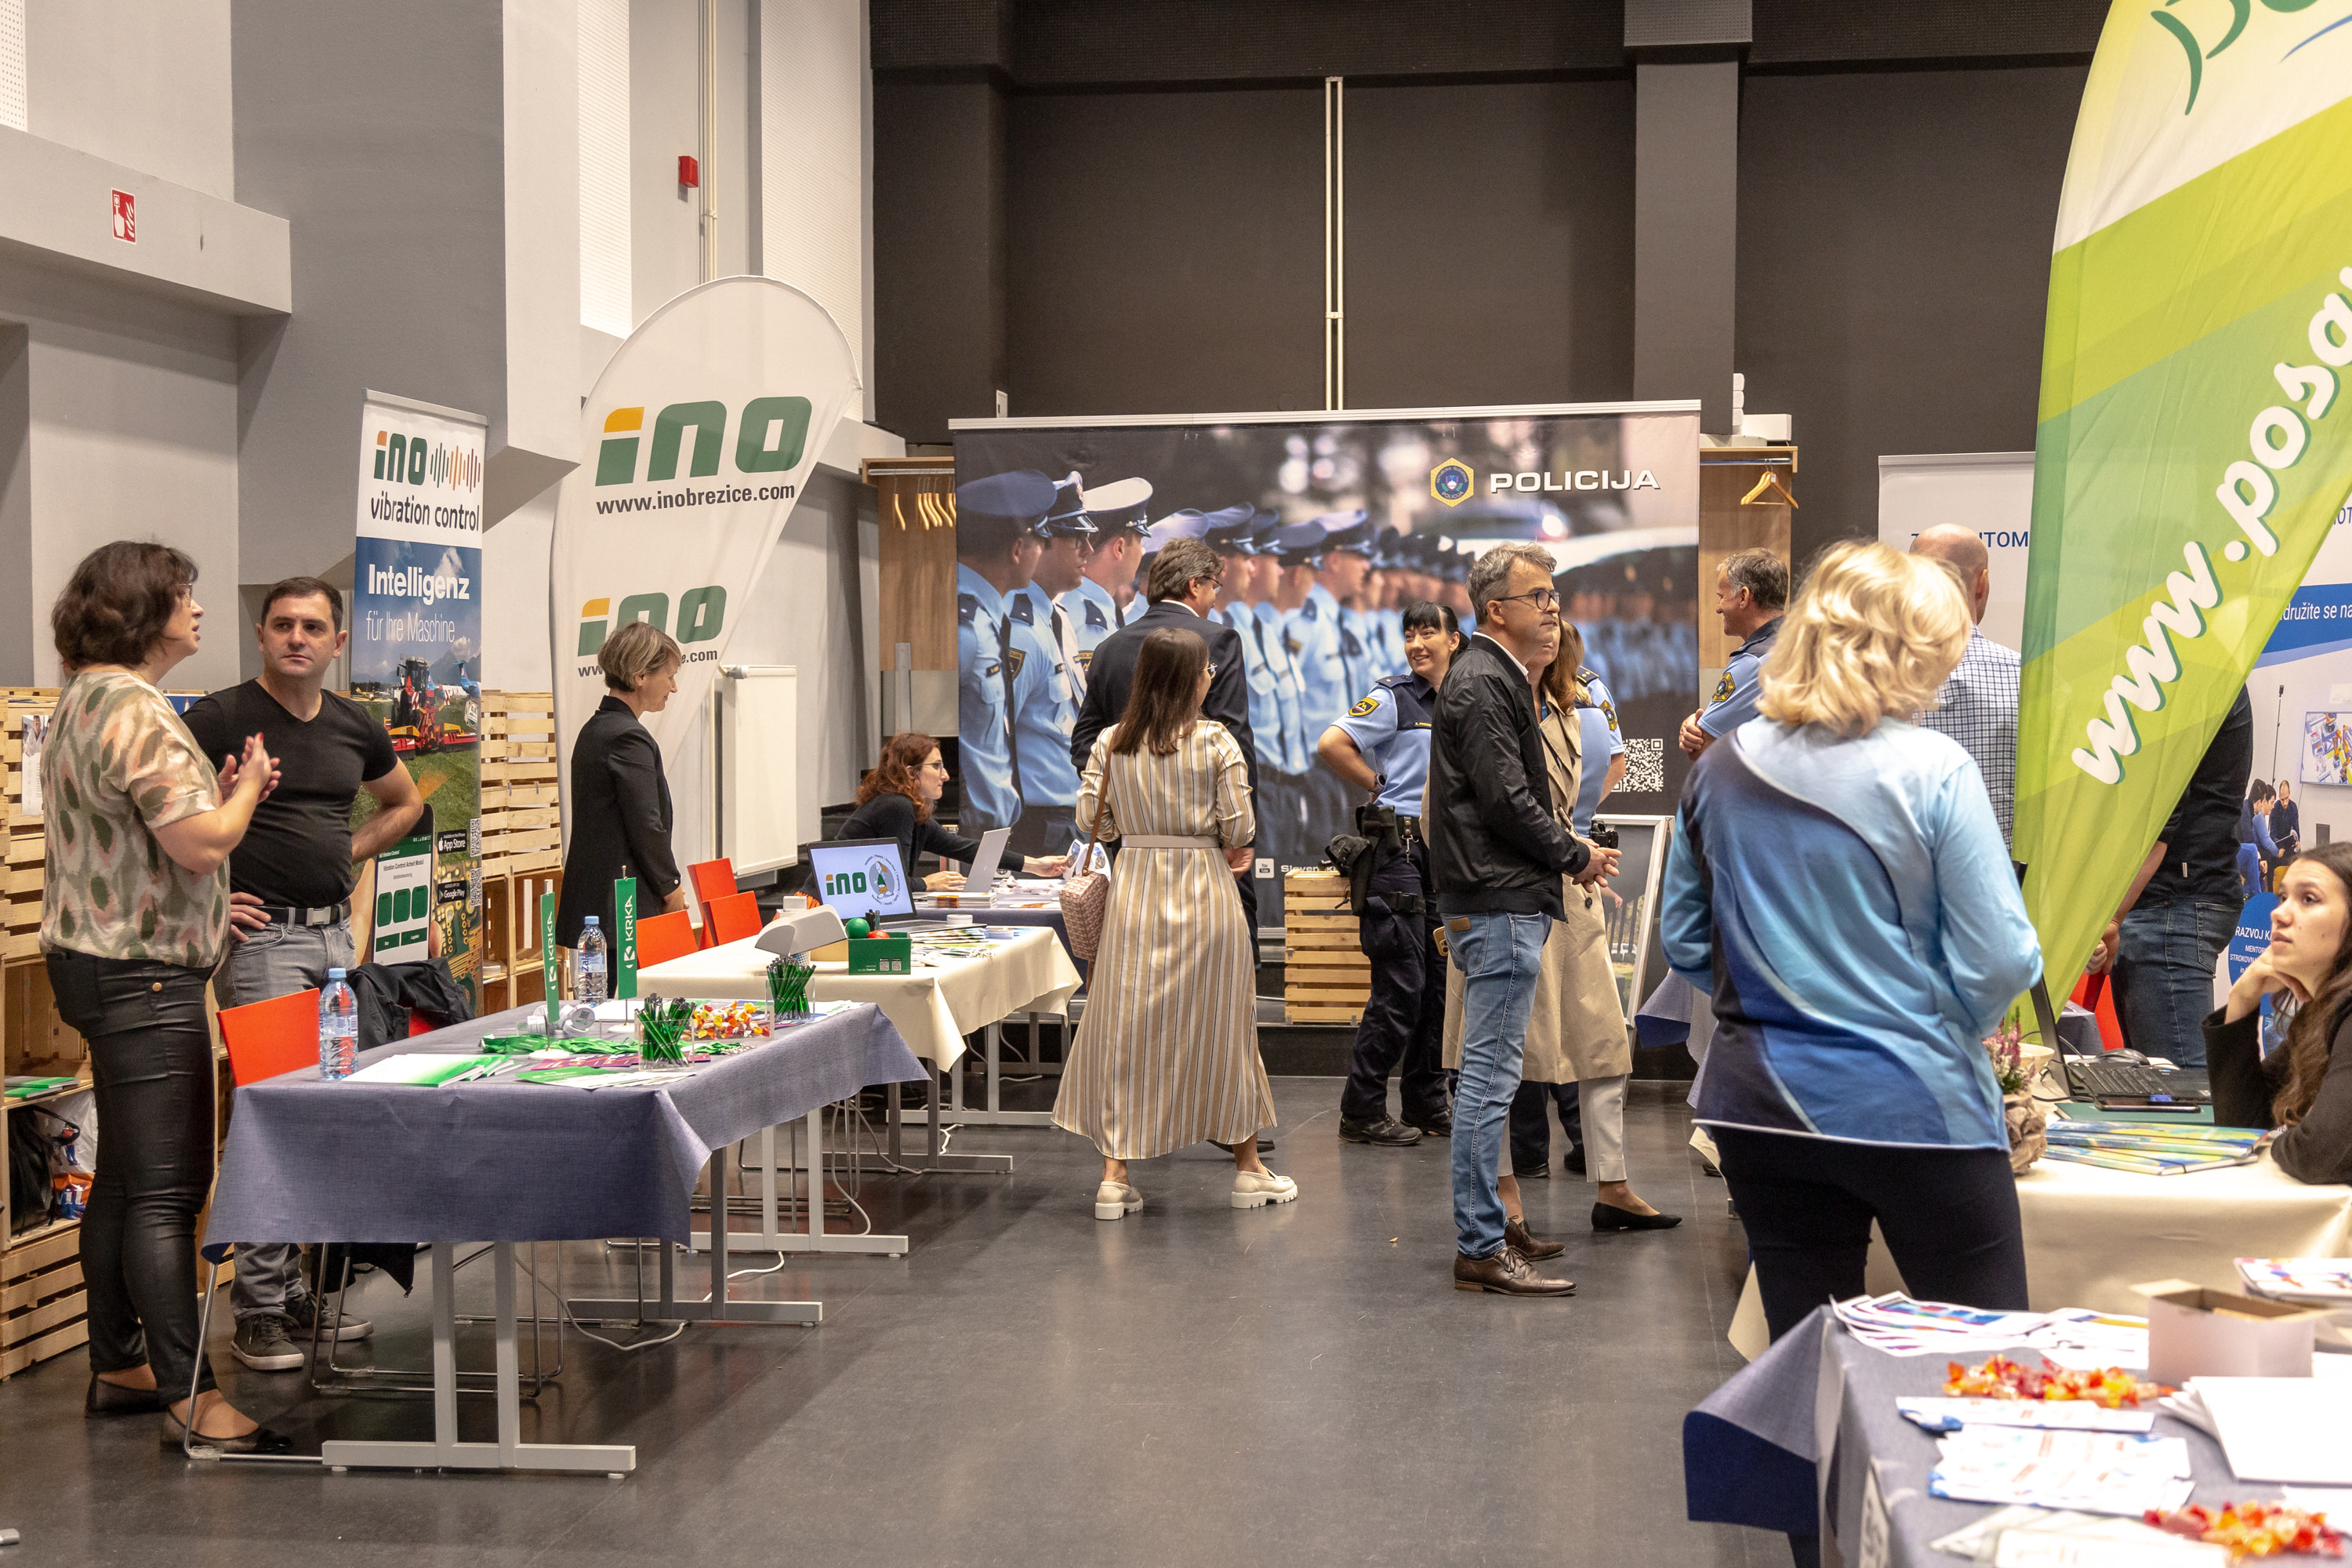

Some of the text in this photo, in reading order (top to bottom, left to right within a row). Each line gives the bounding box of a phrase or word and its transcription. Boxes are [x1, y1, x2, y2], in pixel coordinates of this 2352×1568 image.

[594, 395, 813, 487] ino
[373, 430, 428, 486] ino
[1490, 469, 1661, 493] POLICIJA
[371, 490, 480, 532] vibration control
[596, 481, 796, 515] www.inobrezice.com
[368, 564, 470, 605] Intelligenz
[2323, 604, 2338, 619] se
[366, 610, 456, 643] für Ihre Maschine
[443, 838, 466, 851] App Store
[444, 889, 466, 899] Google Play
[826, 872, 867, 896] ino
[625, 895, 633, 942] KRKA
[2235, 926, 2263, 940] RAZVOJ
[581, 953, 590, 972] Zala
